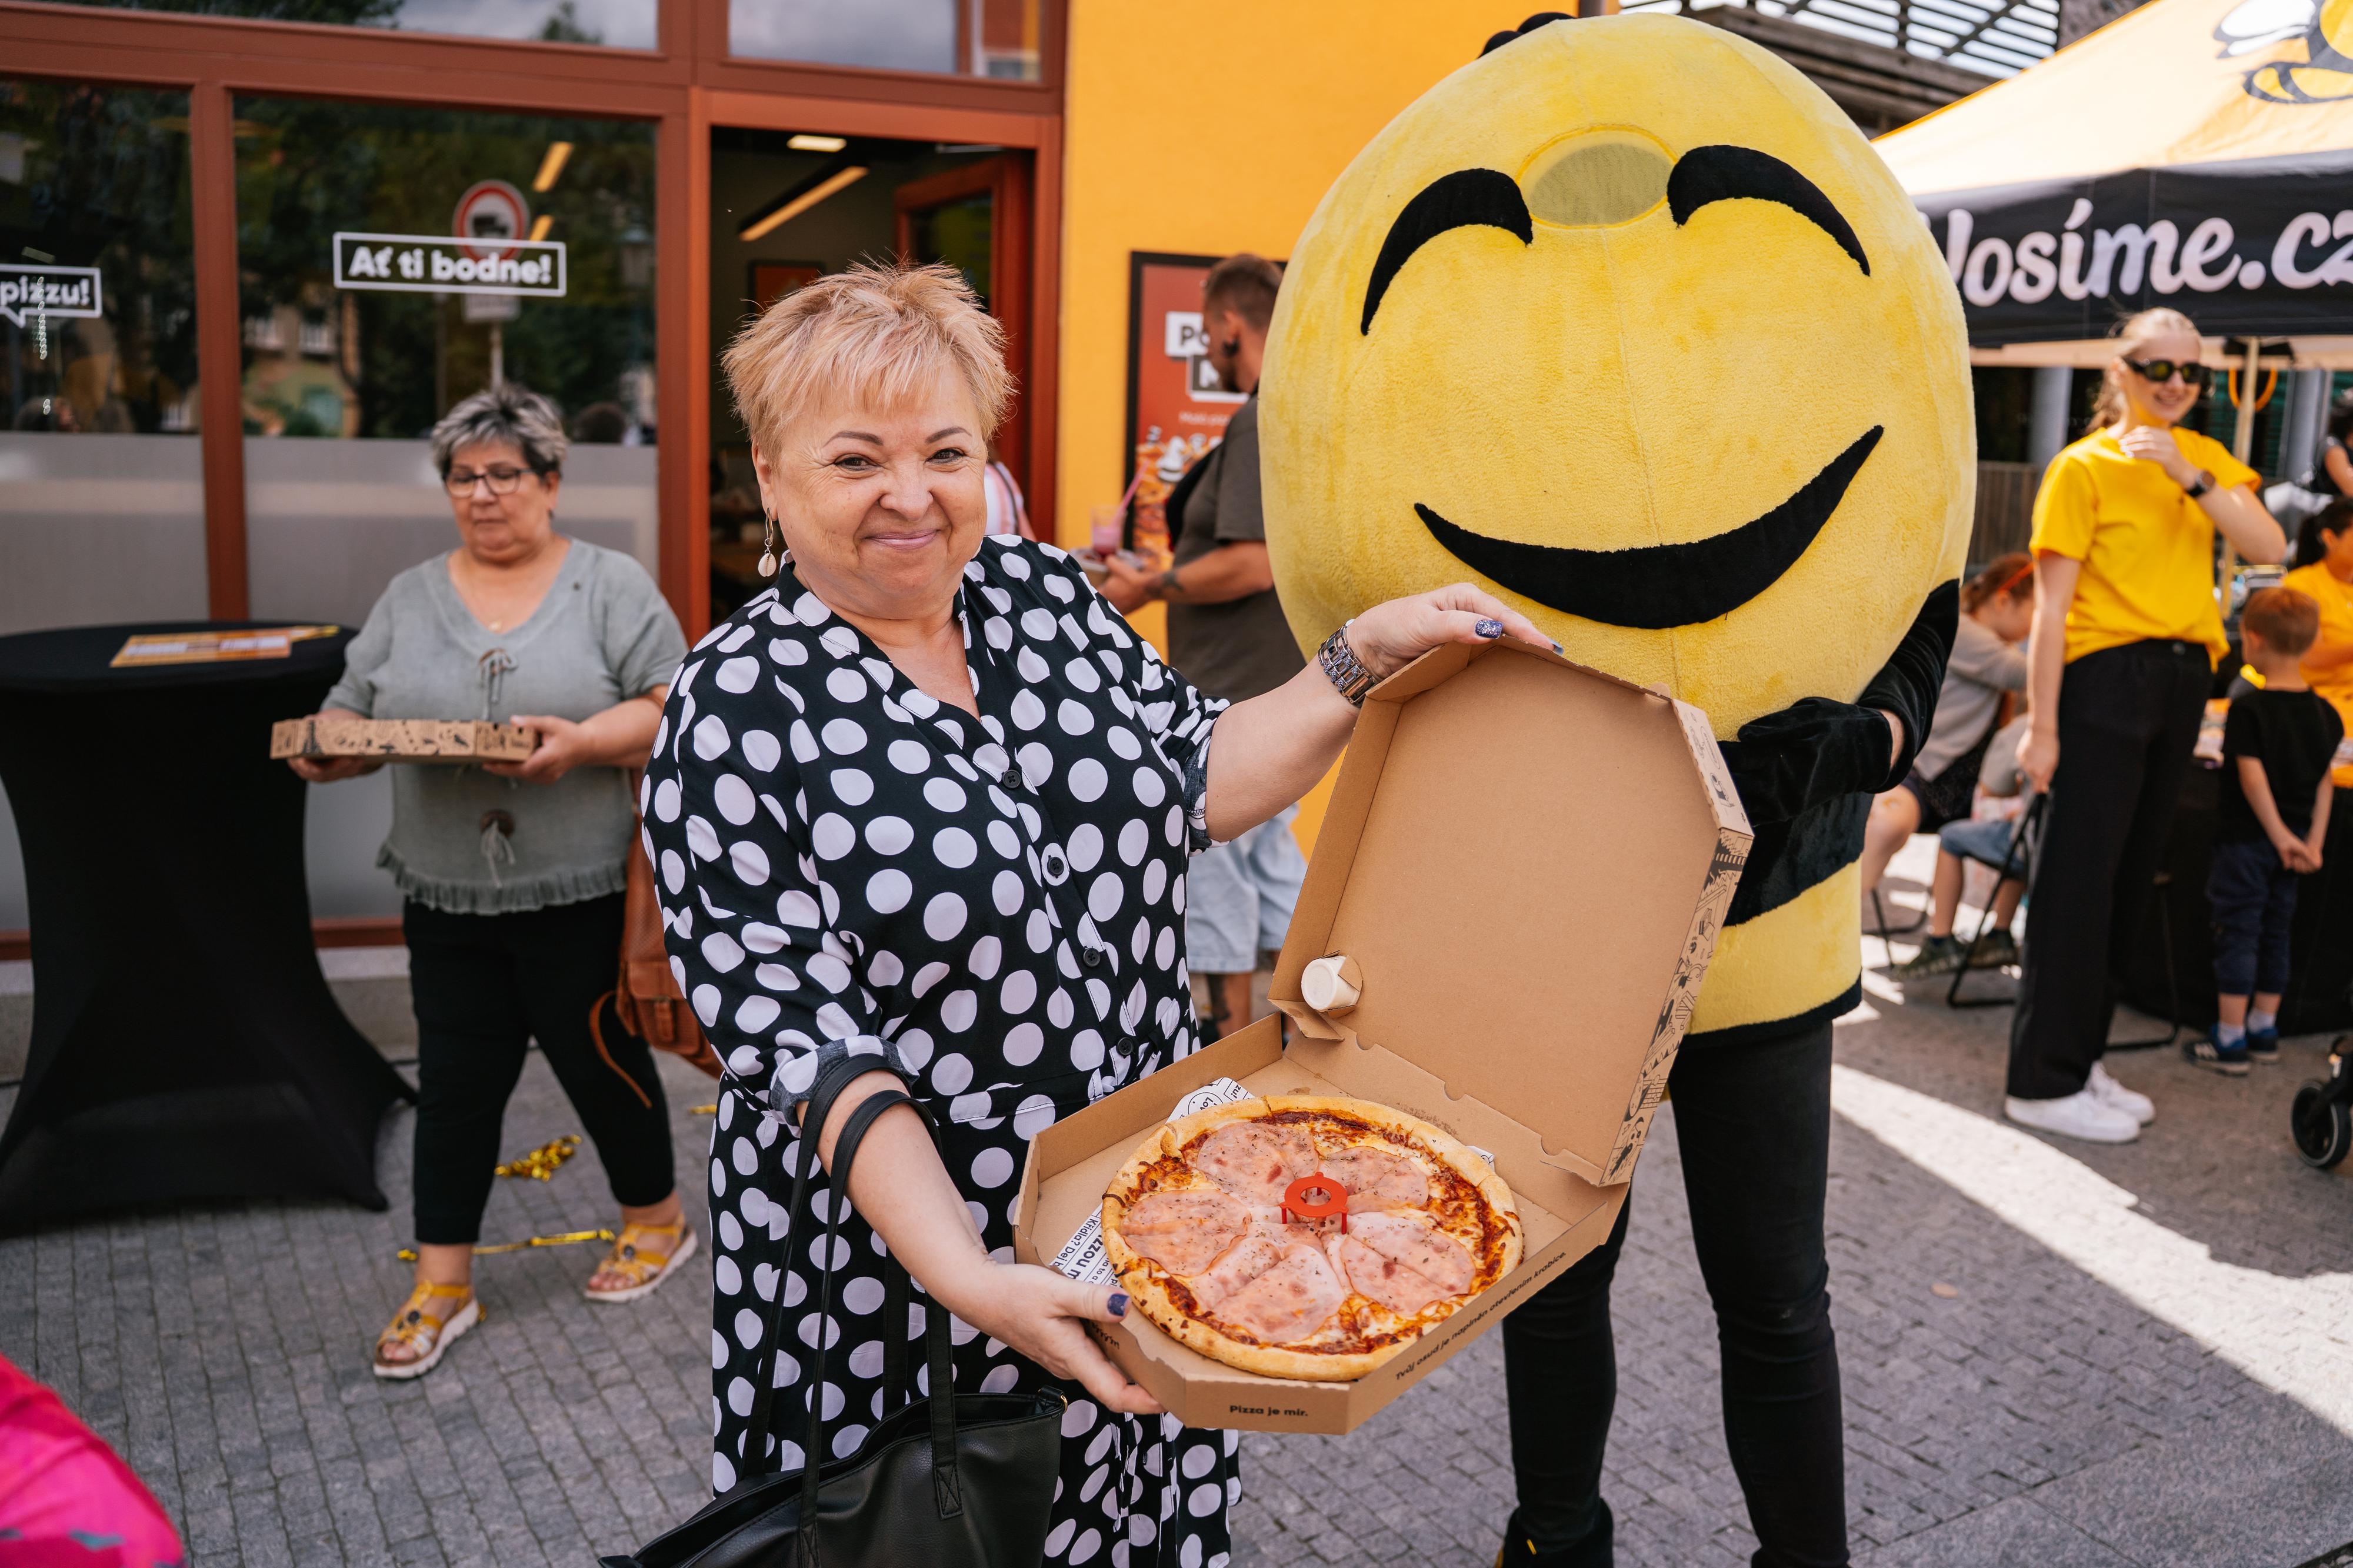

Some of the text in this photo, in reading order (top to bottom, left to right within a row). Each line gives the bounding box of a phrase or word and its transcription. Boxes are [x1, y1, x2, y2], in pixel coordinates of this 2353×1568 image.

[348, 246, 552, 285] Ať ti bodne!
[0, 275, 90, 306] pizzu!
[1056, 1246, 1075, 1262] Dej
[1075, 1235, 1104, 1268] zzou
[1417, 1344, 1439, 1365] osud
[1440, 1339, 1449, 1350] je
[1534, 1252, 1566, 1278] krabice.
[1229, 1404, 1264, 1414] Pizza
[1267, 1406, 1280, 1416] je
